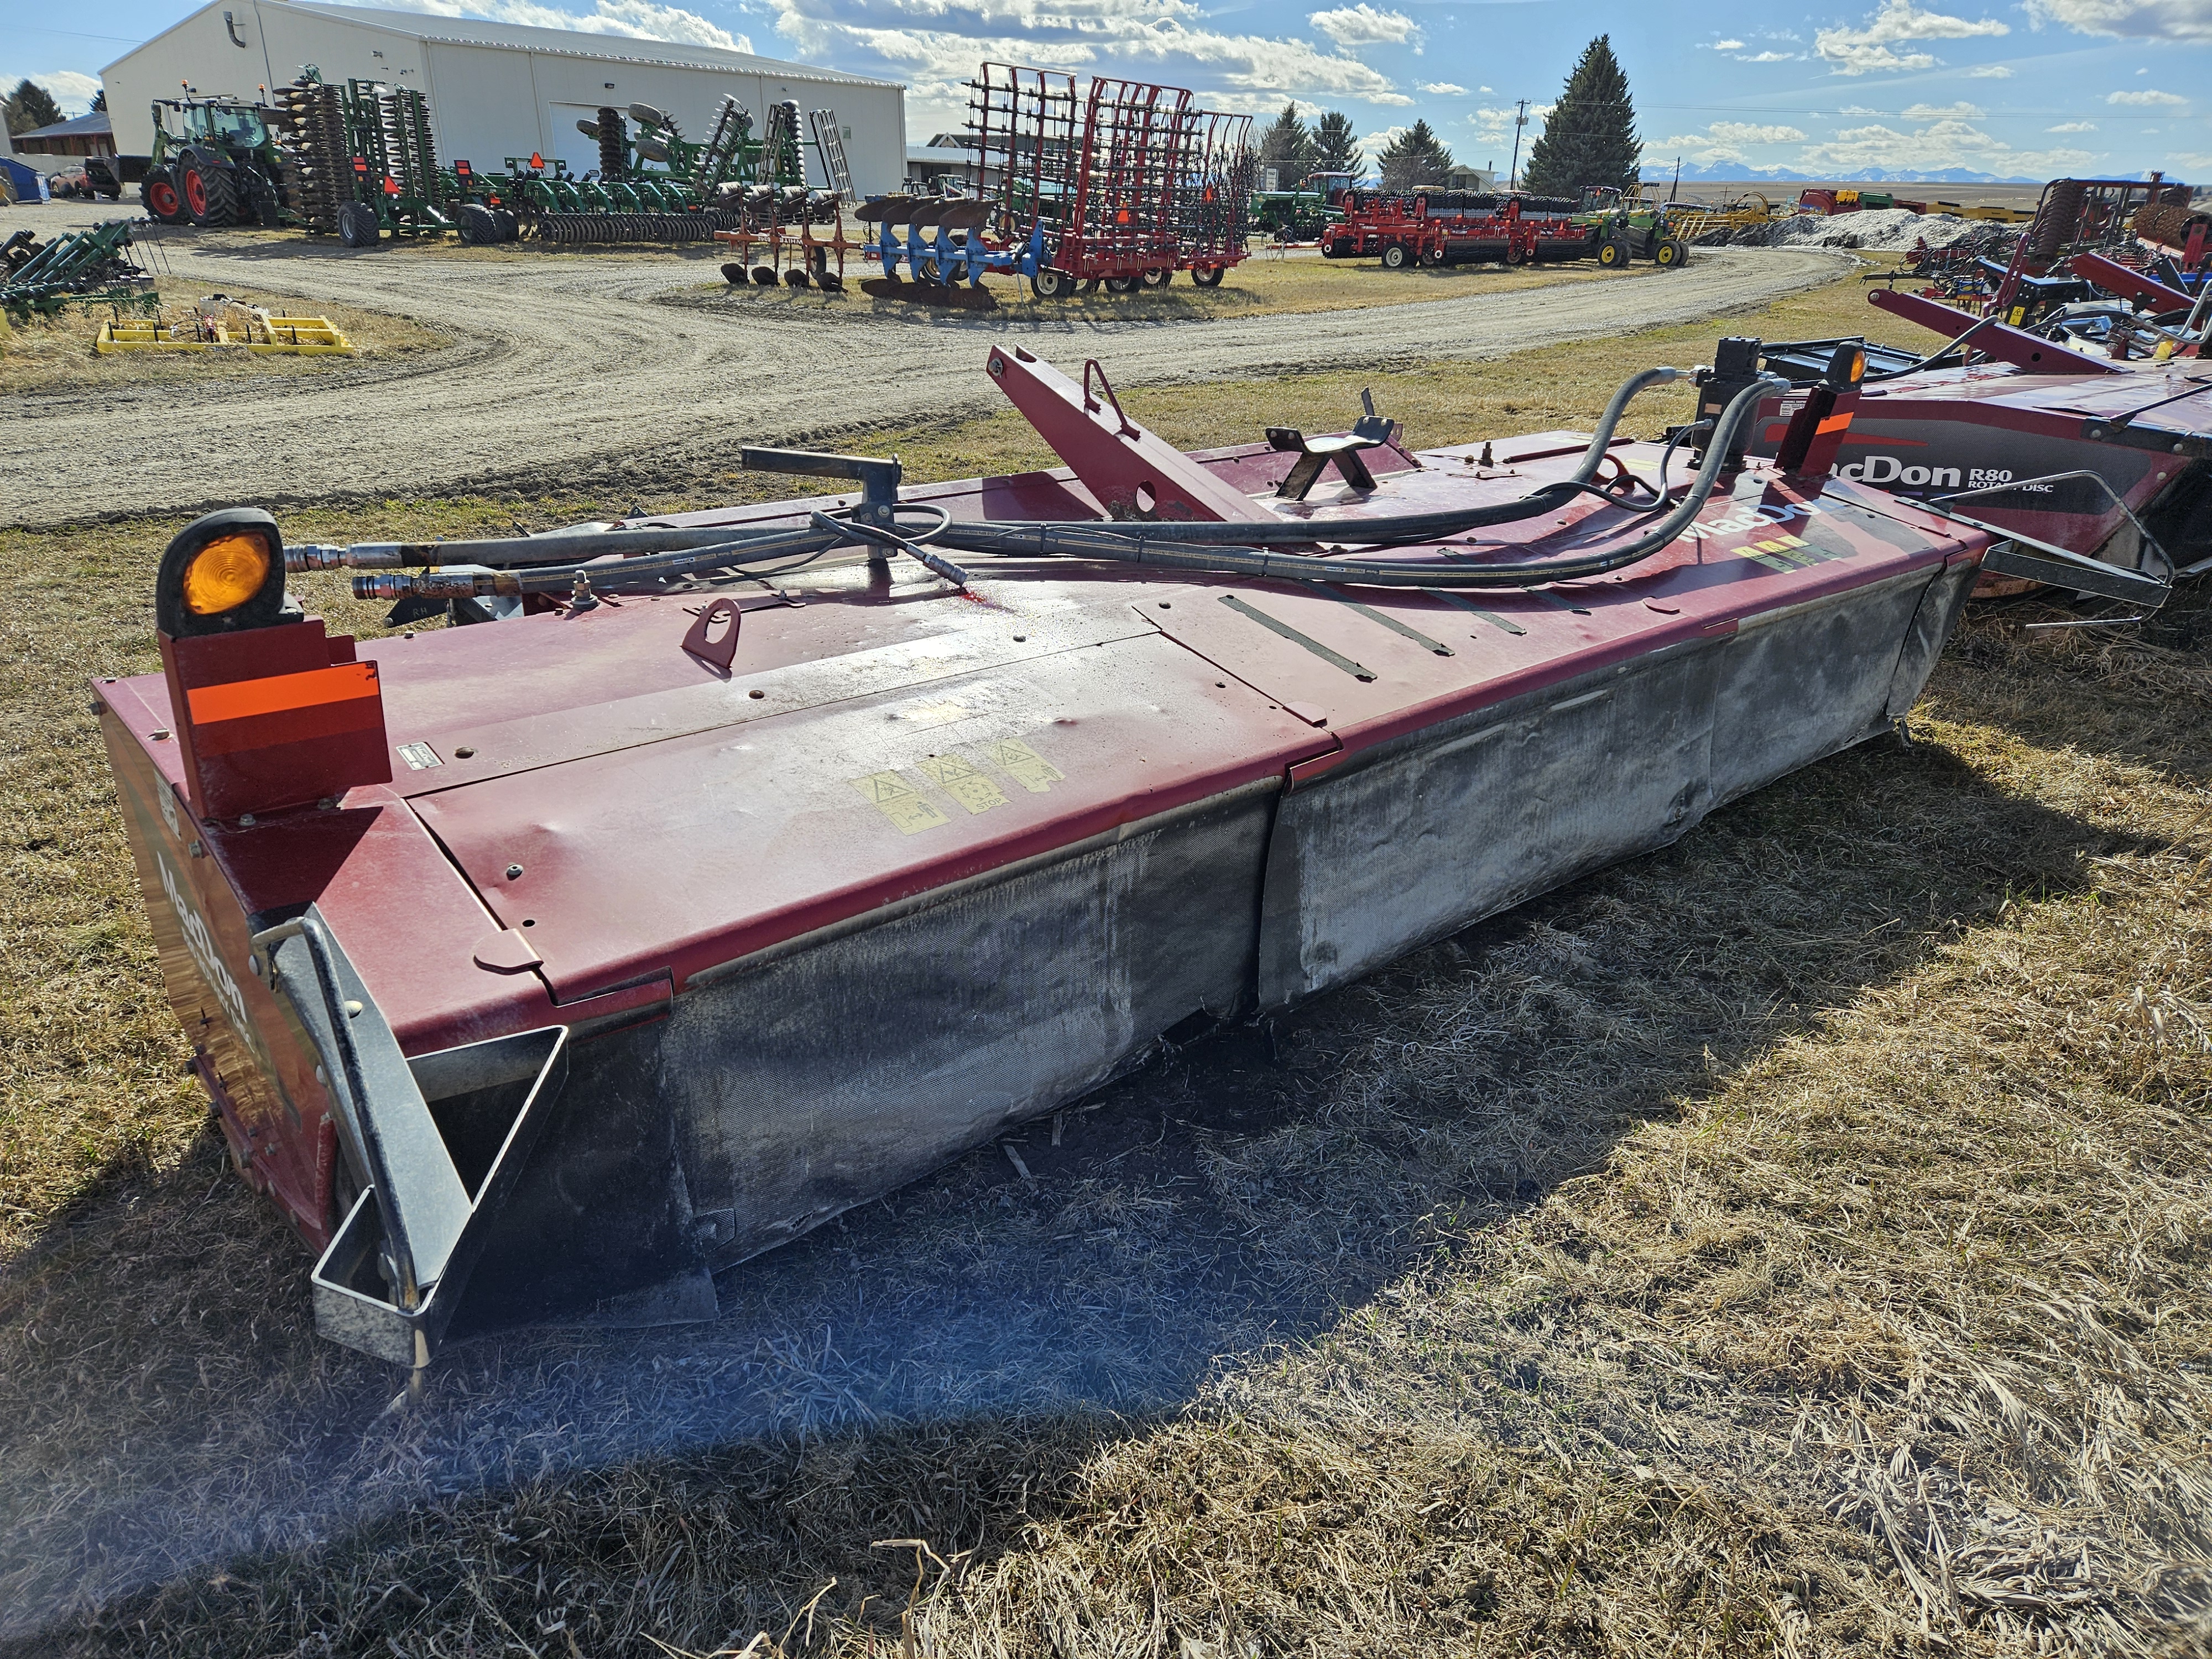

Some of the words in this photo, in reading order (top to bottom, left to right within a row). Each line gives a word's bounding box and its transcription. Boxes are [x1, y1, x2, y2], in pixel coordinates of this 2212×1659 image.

[1969, 468, 2013, 482] R80
[413, 607, 427, 618] RH
[976, 797, 1001, 810] STOP
[157, 851, 247, 1024] MacDon
